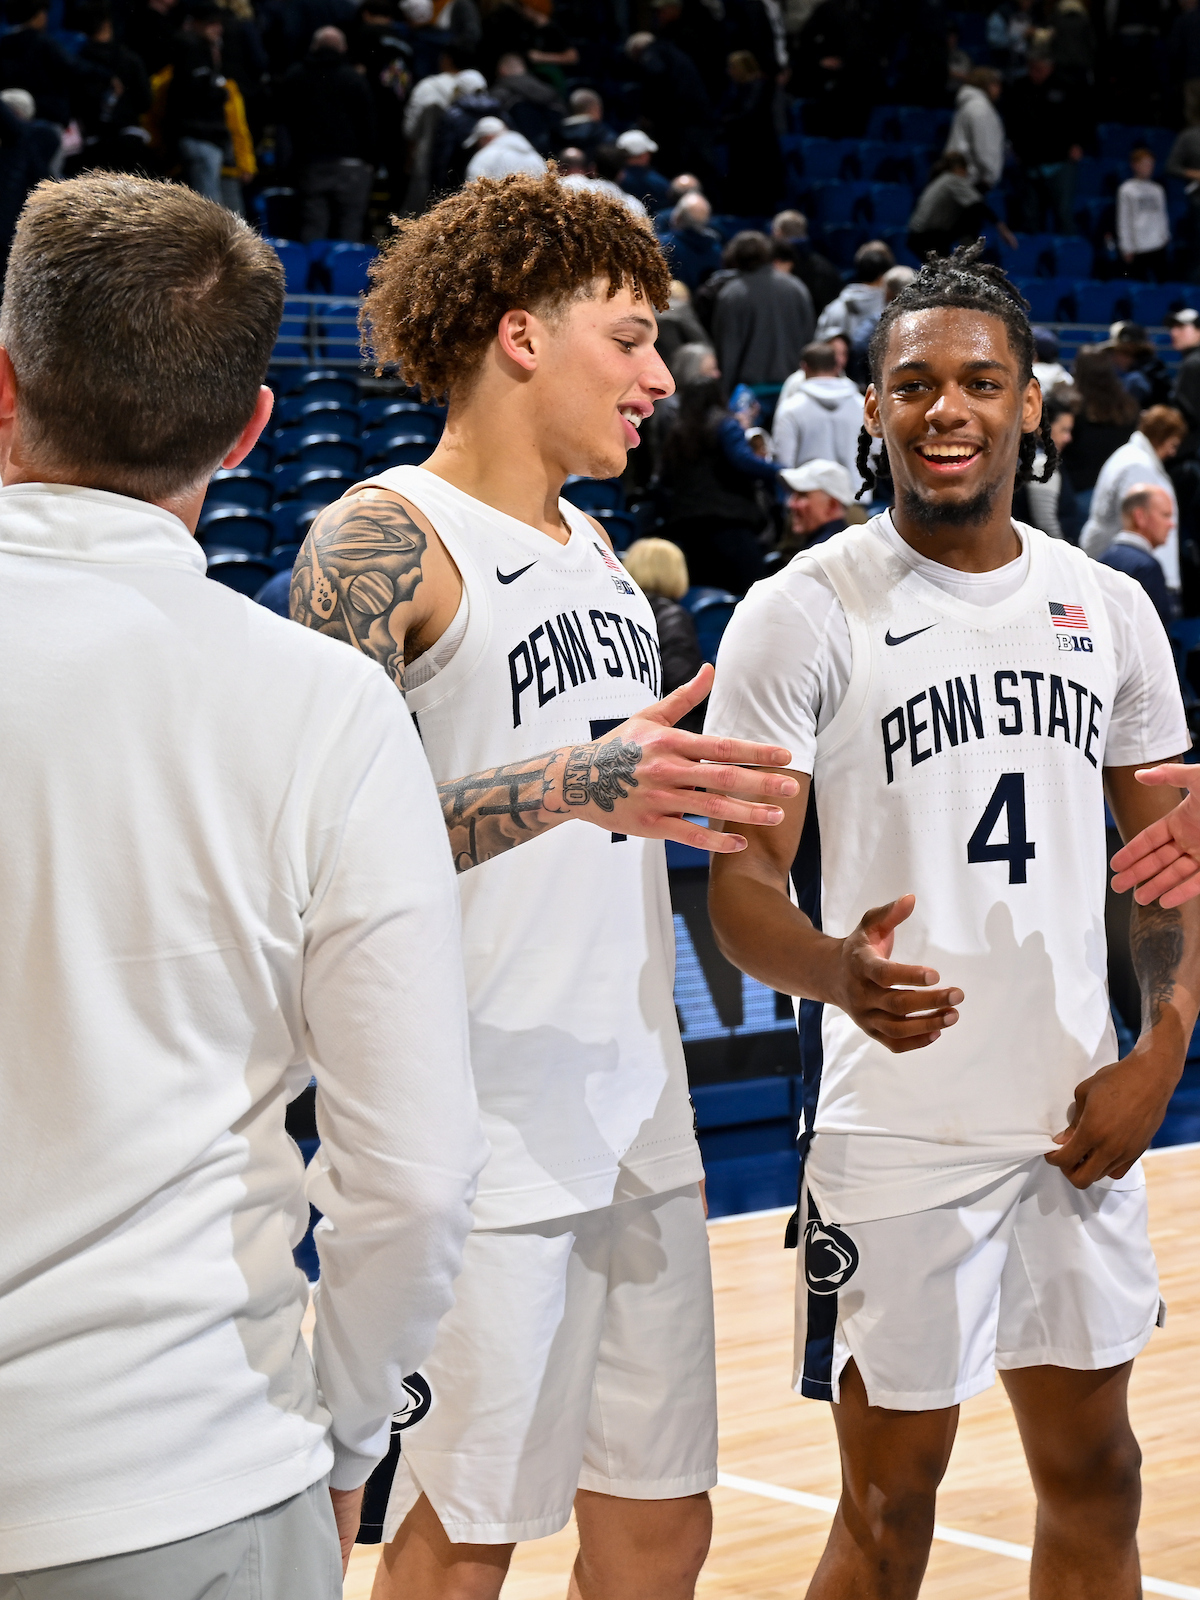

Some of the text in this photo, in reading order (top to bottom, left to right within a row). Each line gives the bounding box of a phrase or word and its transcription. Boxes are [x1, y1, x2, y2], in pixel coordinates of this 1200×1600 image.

[508, 609, 597, 729] PENN
[881, 670, 1103, 785] PENN STATE
[967, 772, 1035, 884] 4
